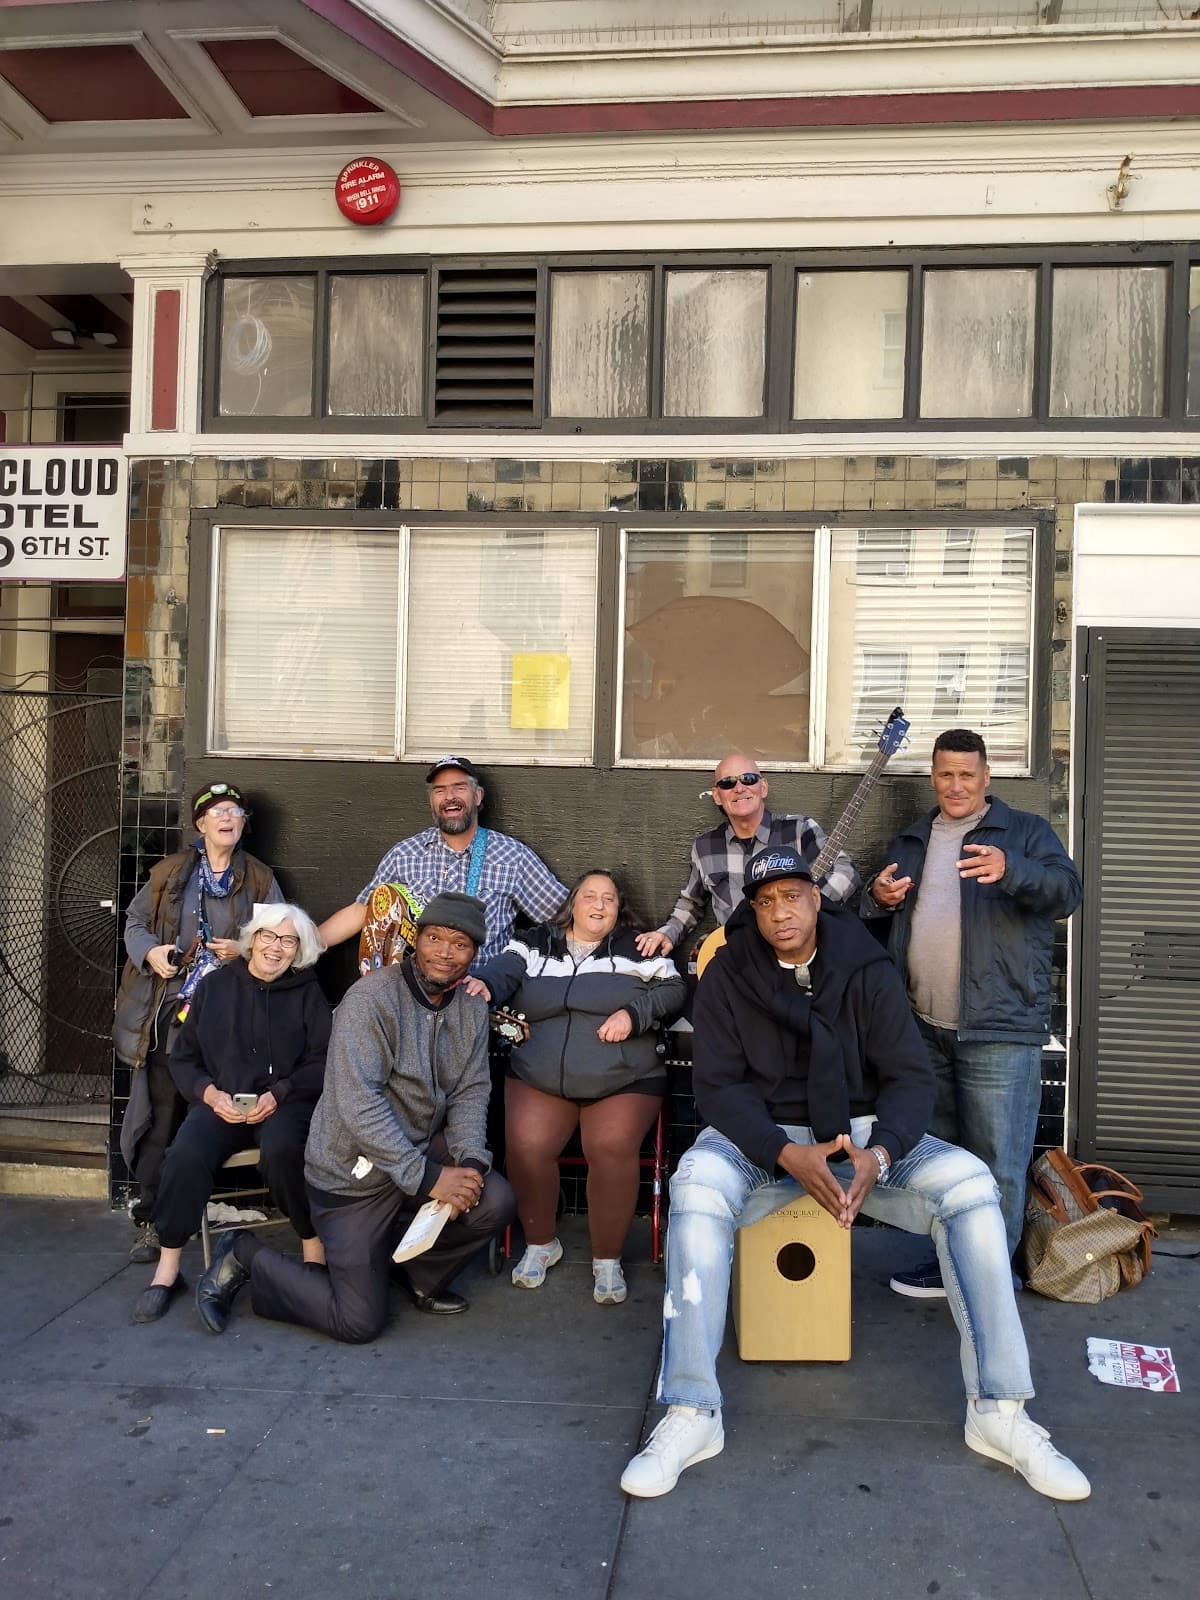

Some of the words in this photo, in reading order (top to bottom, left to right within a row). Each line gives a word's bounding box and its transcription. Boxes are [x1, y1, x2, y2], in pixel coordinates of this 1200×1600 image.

[340, 180, 358, 191] FIRE
[358, 172, 385, 184] ALARM
[341, 161, 379, 182] SPRINKLER
[0, 458, 119, 496] CLOUD
[21, 536, 70, 556] 6TH
[78, 536, 110, 557] ST.
[752, 853, 797, 880] California
